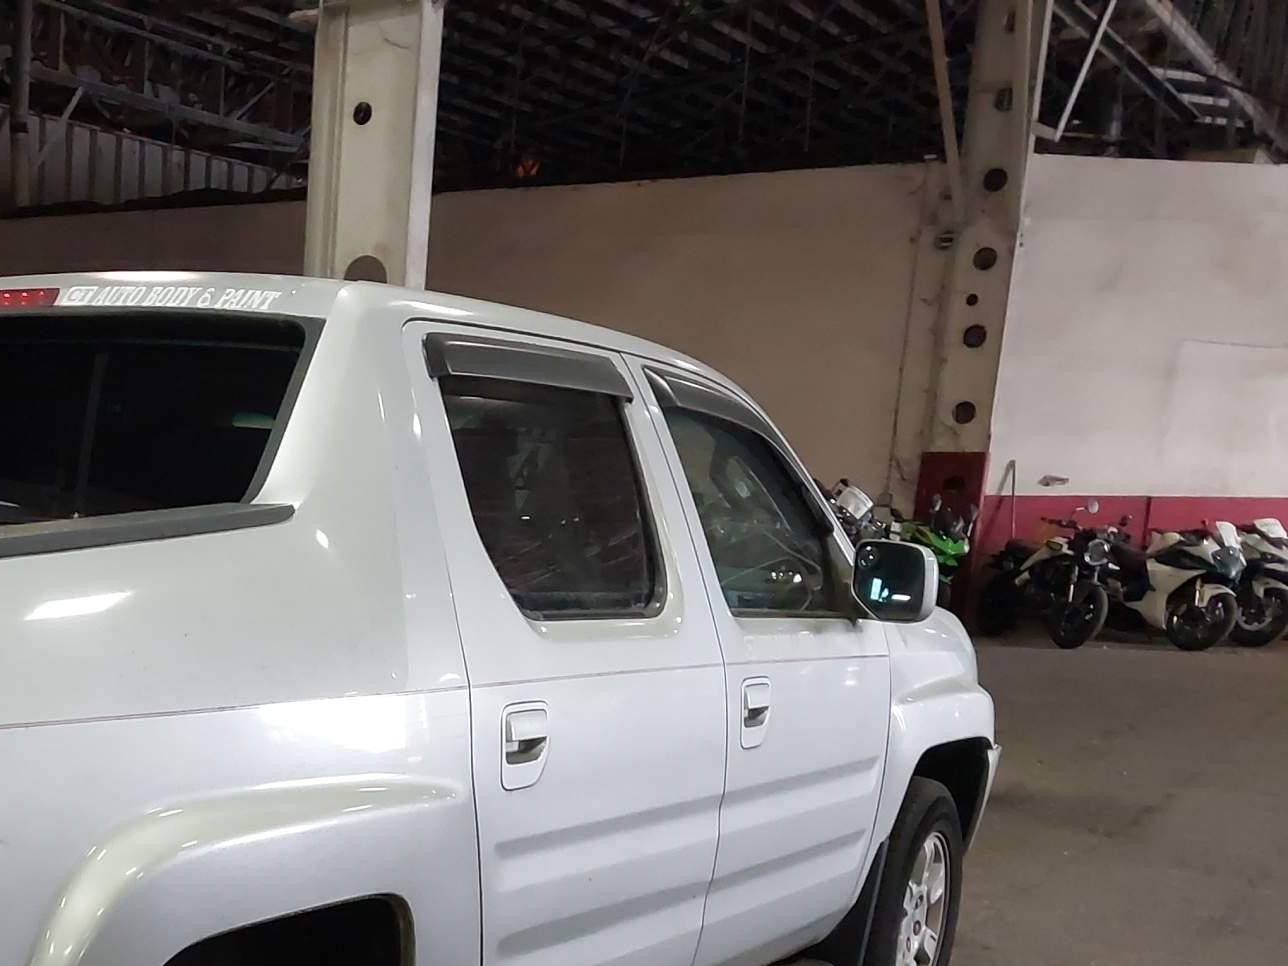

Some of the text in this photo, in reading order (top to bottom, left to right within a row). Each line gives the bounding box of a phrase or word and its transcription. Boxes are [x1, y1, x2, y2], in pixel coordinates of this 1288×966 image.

[94, 286, 147, 306] AUTO
[143, 287, 203, 307] BODY
[197, 288, 215, 308] &
[214, 289, 283, 310] PAINT
